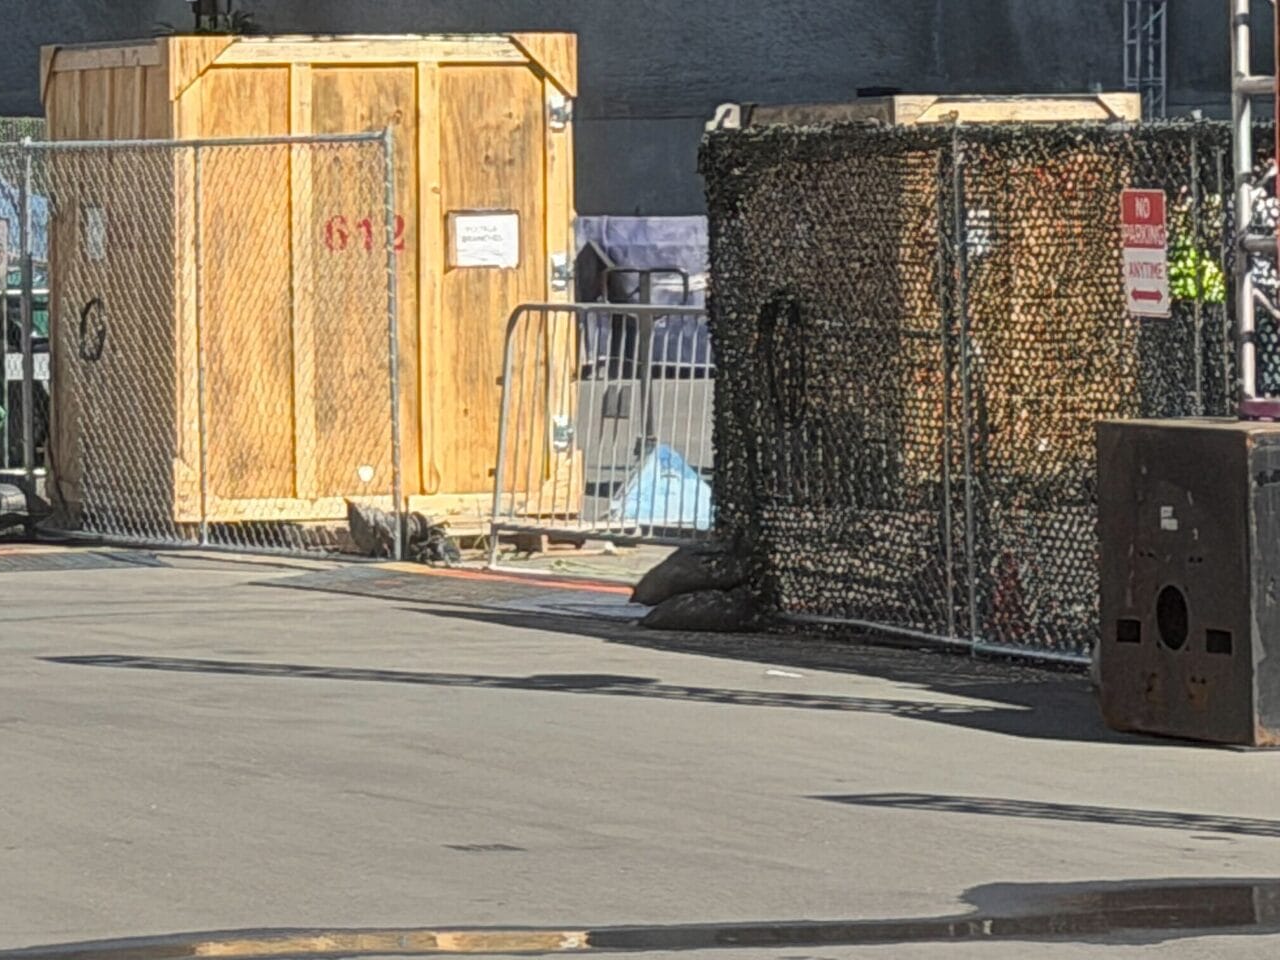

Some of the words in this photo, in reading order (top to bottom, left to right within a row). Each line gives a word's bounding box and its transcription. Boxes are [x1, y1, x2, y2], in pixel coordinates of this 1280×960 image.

[1135, 196, 1151, 219] NO
[324, 214, 405, 253] 612
[1123, 224, 1164, 245] PARKING
[1129, 261, 1163, 279] ANYTIME
